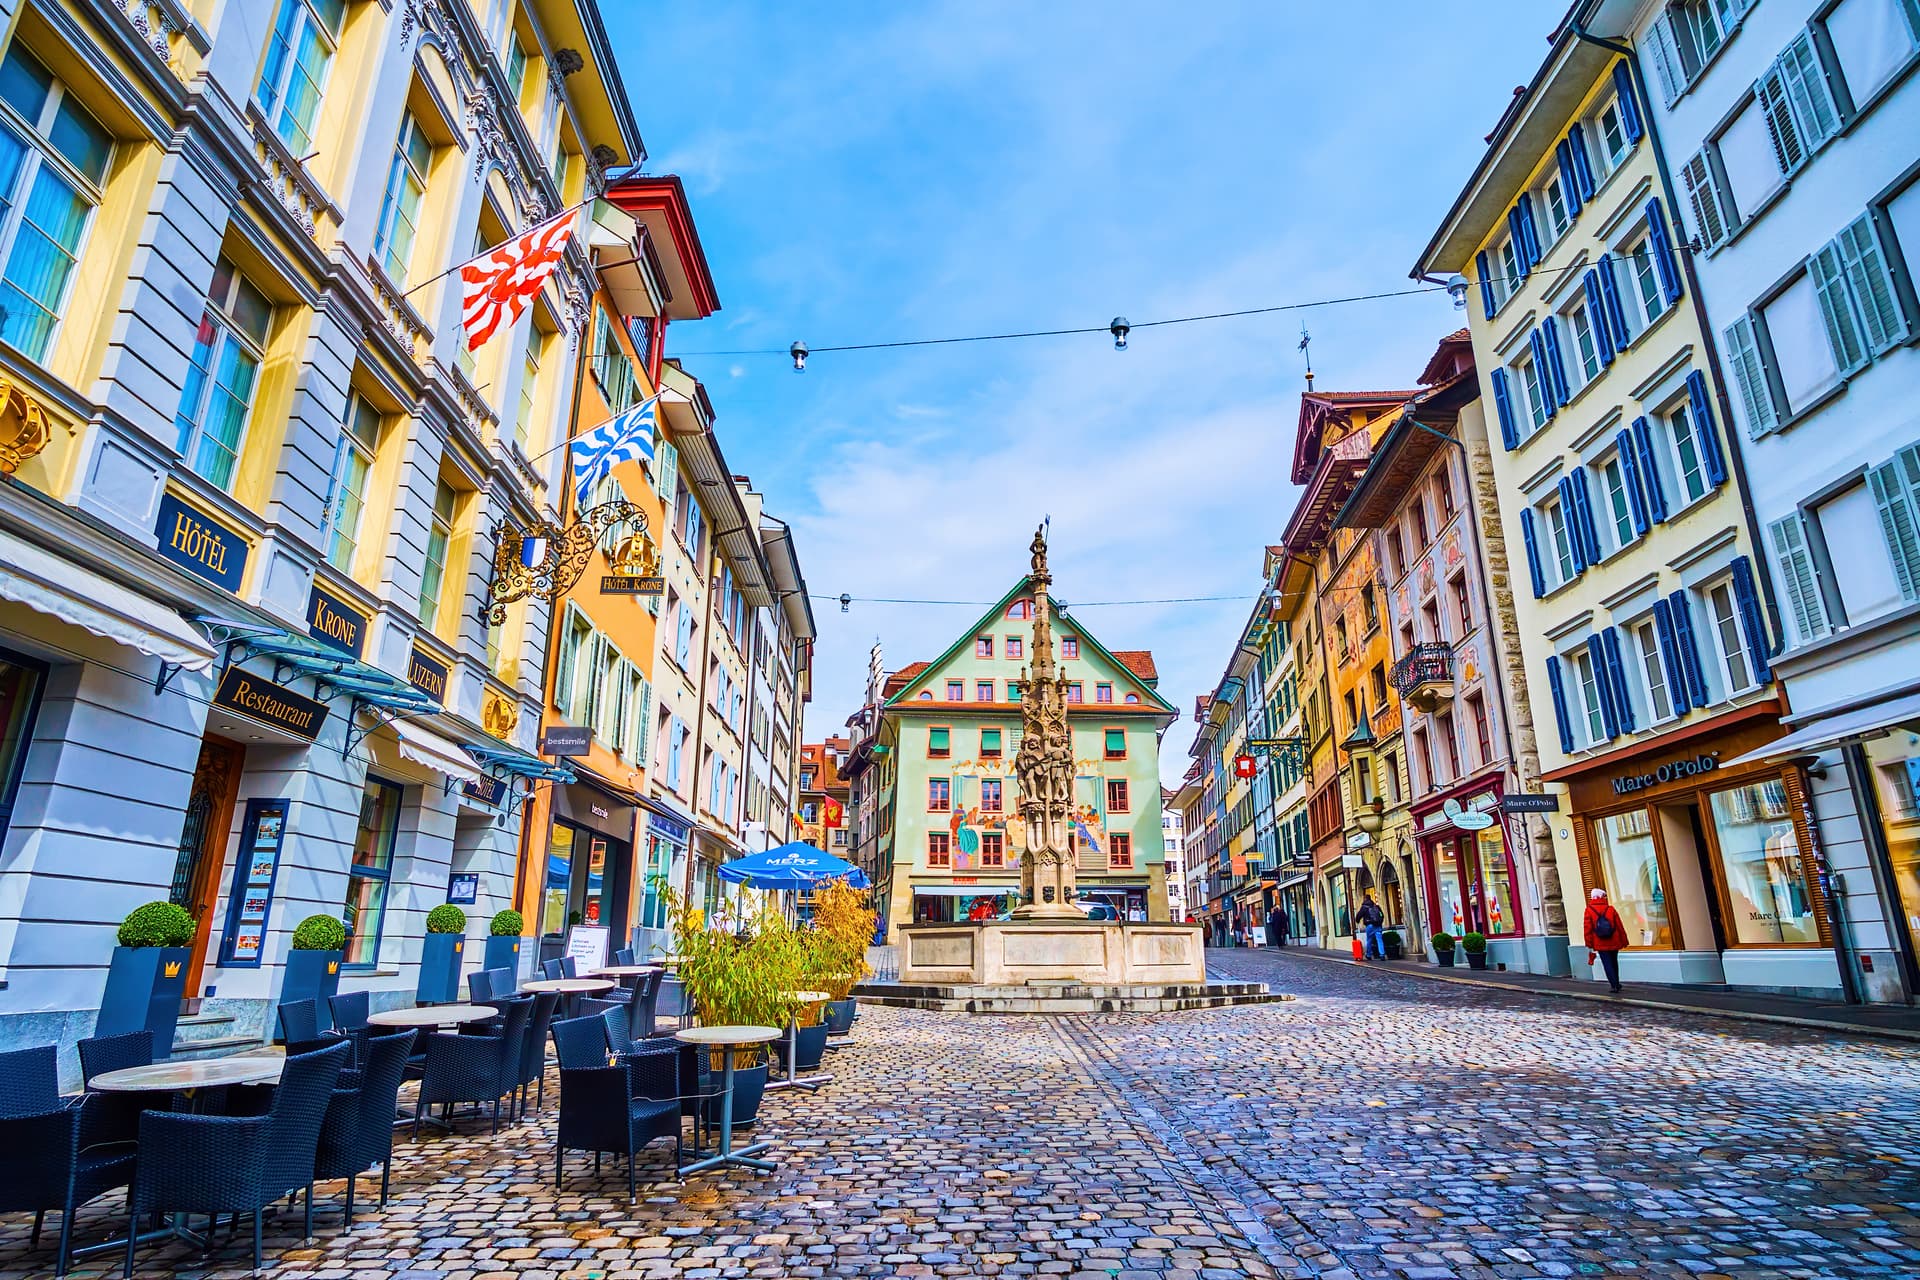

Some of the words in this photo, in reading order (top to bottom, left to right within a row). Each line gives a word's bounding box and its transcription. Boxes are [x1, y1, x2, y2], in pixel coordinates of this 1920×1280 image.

[634, 578, 662, 591] KRONE
[313, 598, 357, 648] KRONE
[407, 655, 443, 697] LUZERN
[232, 680, 313, 729] Restaurant
[547, 737, 586, 745] bestsmile
[1610, 773, 1653, 796] Marc
[1656, 754, 1713, 783] O'Polo
[1506, 799, 1527, 807] Marc
[1528, 799, 1554, 807] O'Polo
[765, 858, 819, 866] MERZ
[1749, 911, 1772, 921] Marc
